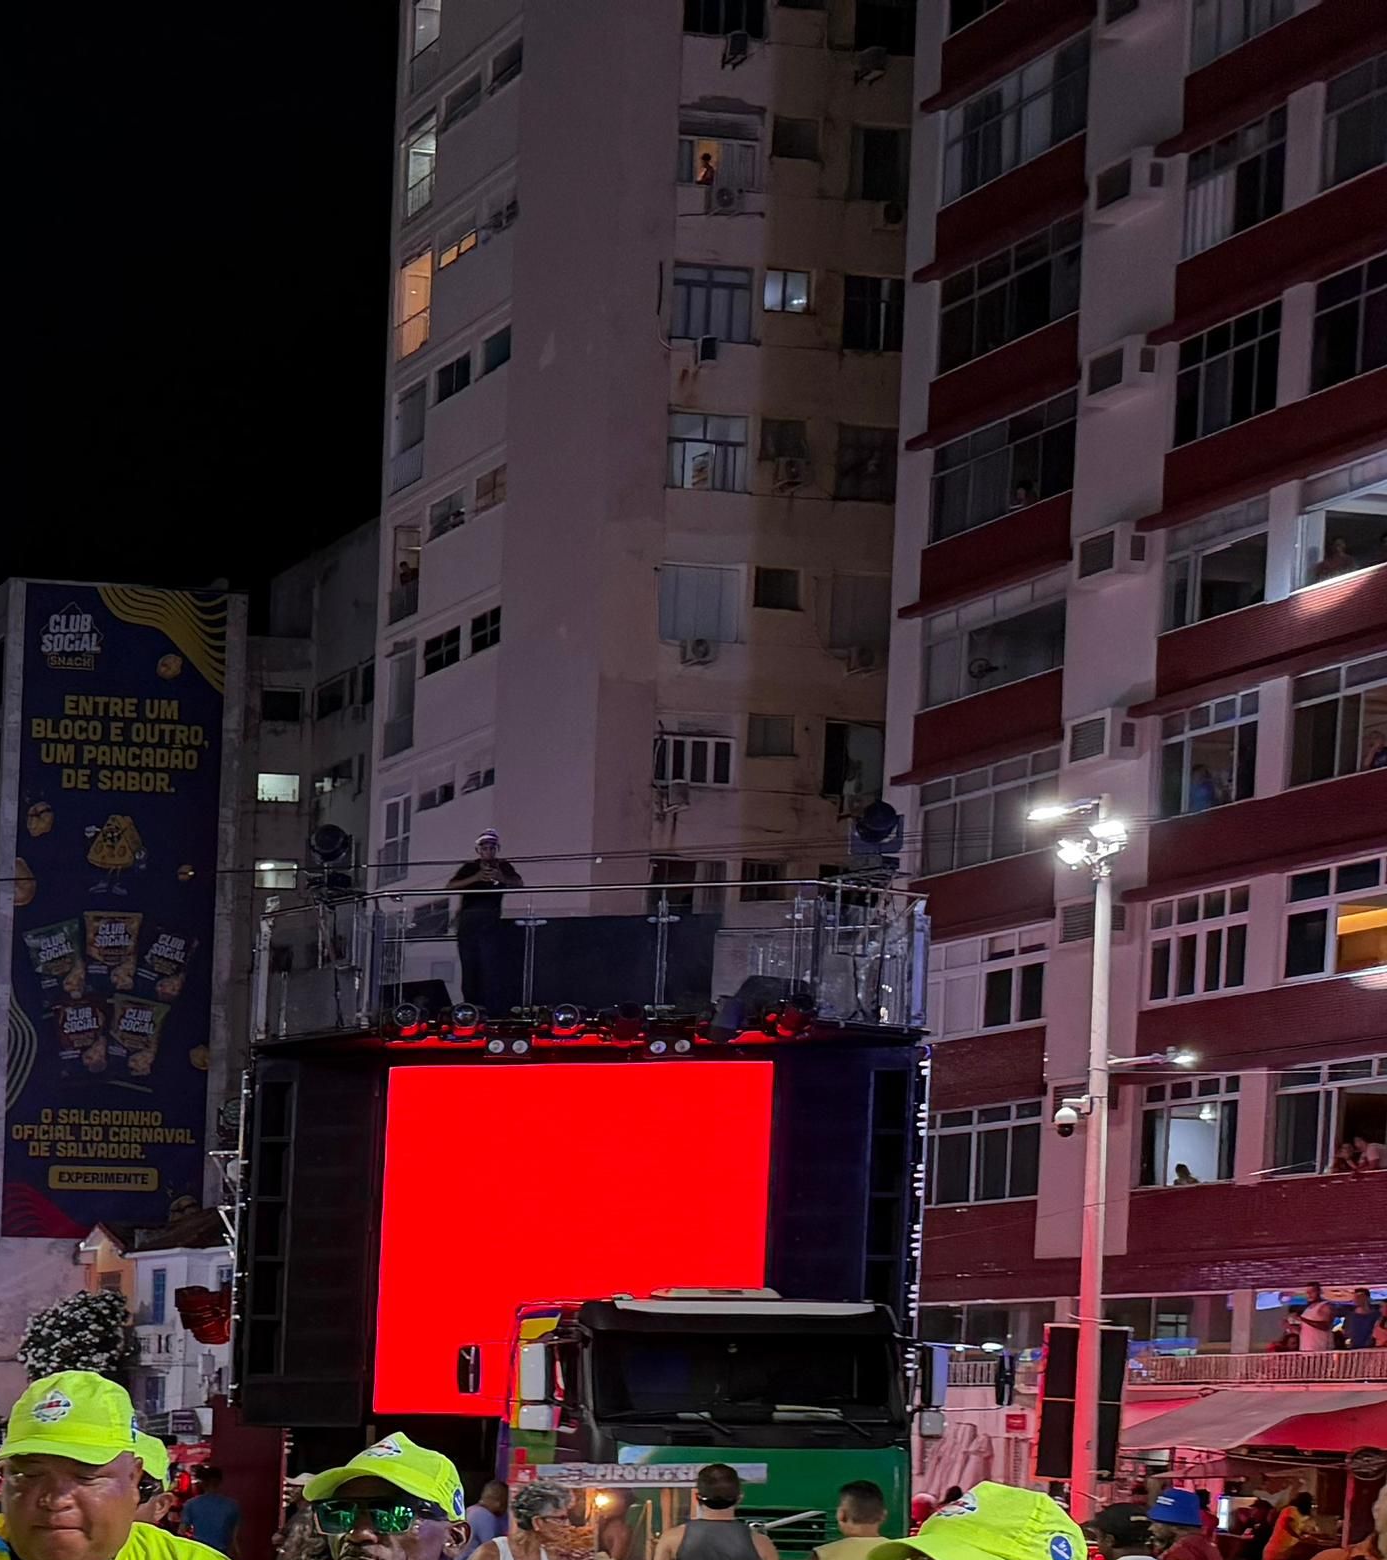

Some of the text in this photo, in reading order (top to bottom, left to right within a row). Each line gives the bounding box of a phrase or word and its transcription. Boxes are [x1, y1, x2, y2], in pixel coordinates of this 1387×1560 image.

[49, 614, 93, 633] CLUB
[50, 655, 92, 668] SNACK
[64, 695, 179, 720] ENTRE UM
[31, 718, 209, 748] BLOCO E OUTRO,
[40, 743, 199, 769] UM PANCADÃO
[62, 768, 175, 792] DE SABOR.
[41, 1109, 163, 1127] O SALGADINHO
[12, 1125, 196, 1144] OFICIAL DO CARNAVAL
[29, 1141, 146, 1160] DE SALVADOR.
[58, 1171, 150, 1186] EXPERIMENTE
